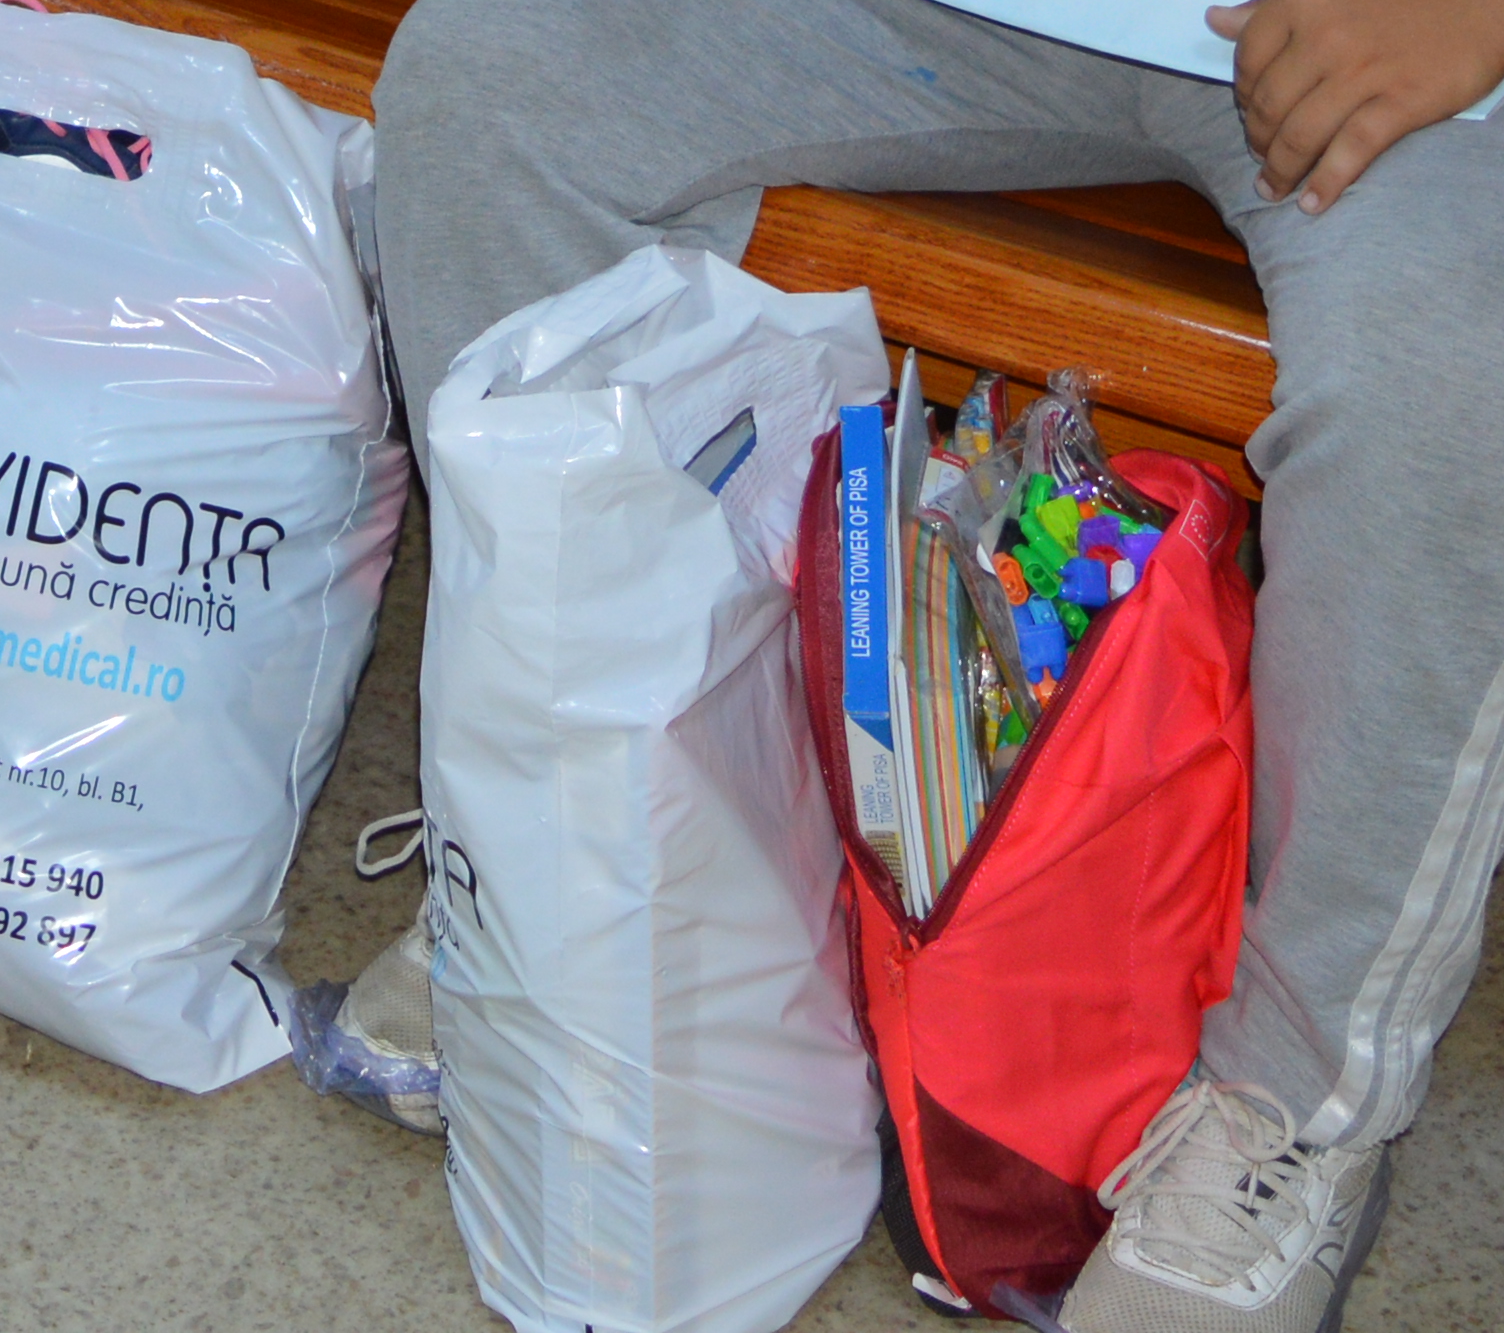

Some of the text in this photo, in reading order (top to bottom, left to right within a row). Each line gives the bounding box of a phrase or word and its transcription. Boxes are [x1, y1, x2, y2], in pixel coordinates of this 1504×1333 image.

[848, 466, 871, 659] LEANING TOWER OF PISA
[88, 579, 236, 637] credință
[77, 772, 103, 801] bl.
[110, 780, 145, 813] B1,
[860, 783, 879, 825] LEANING
[872, 752, 895, 825] TOWER OF PISA
[45, 862, 106, 901] 940
[36, 914, 98, 953] 897
